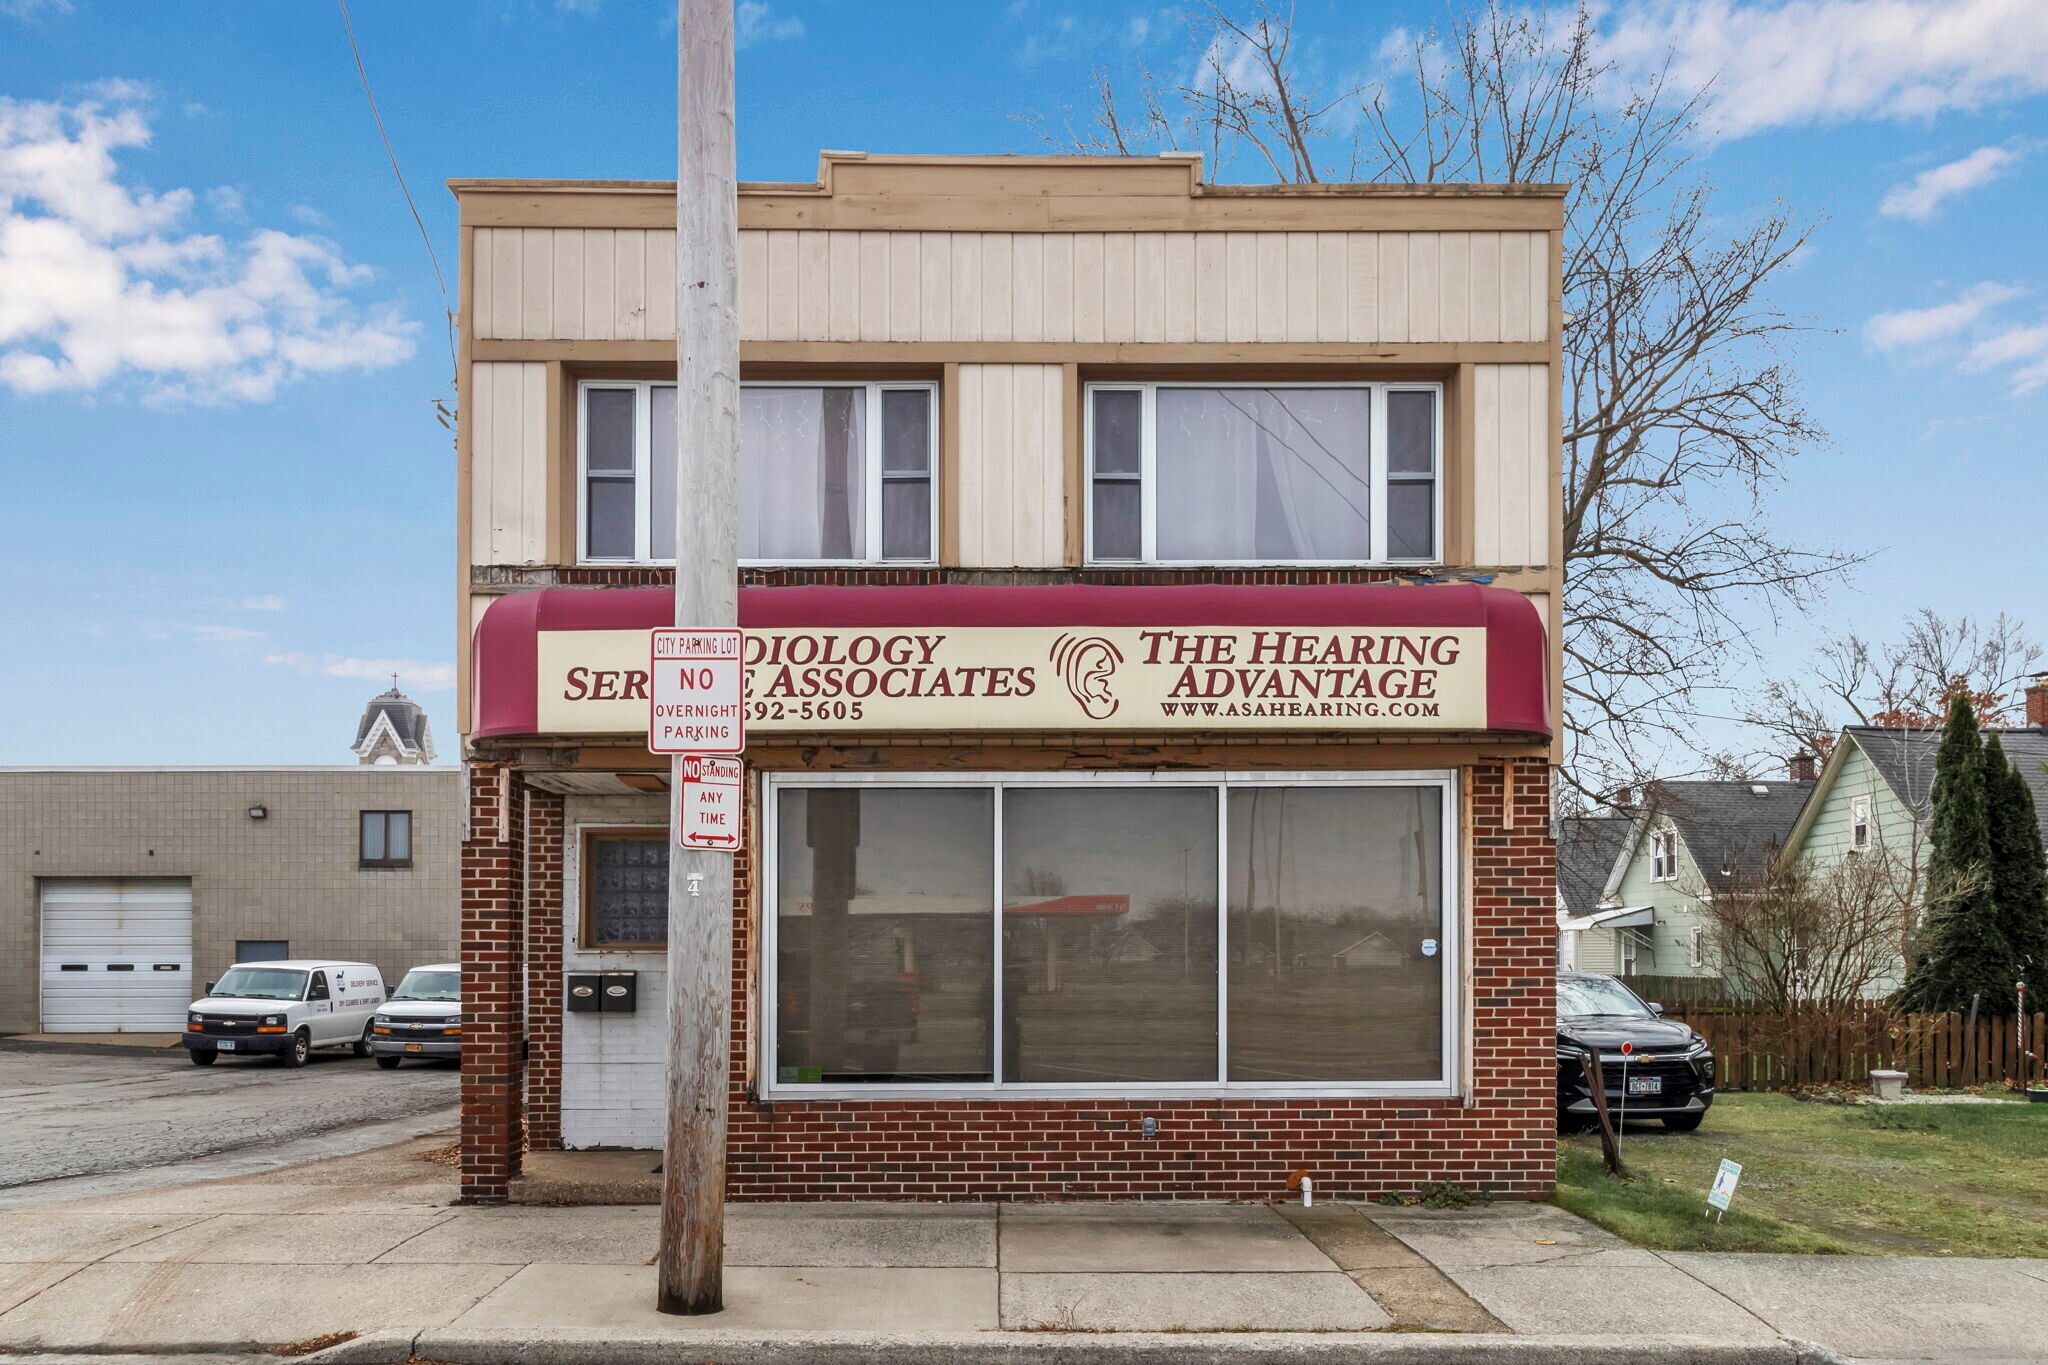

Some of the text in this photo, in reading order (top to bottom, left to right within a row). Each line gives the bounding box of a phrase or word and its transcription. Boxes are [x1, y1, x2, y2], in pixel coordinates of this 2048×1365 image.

[657, 637, 737, 654] CITY PARKING LOT
[745, 634, 946, 666] DIOLOGY
[1139, 630, 1460, 666] THE HEARING
[680, 668, 714, 690] NO
[763, 664, 1035, 700] ASSOCIATES
[1167, 665, 1438, 700] ADVANTAGE
[656, 704, 738, 718] OVERNIGHT
[1160, 702, 1440, 718] WWW.ASAHEARING.COM
[664, 726, 729, 739] PARKING
[684, 760, 739, 779] NO STANDING
[700, 791, 723, 804] ANY
[700, 812, 726, 825] TIME
[687, 880, 700, 897] 4
